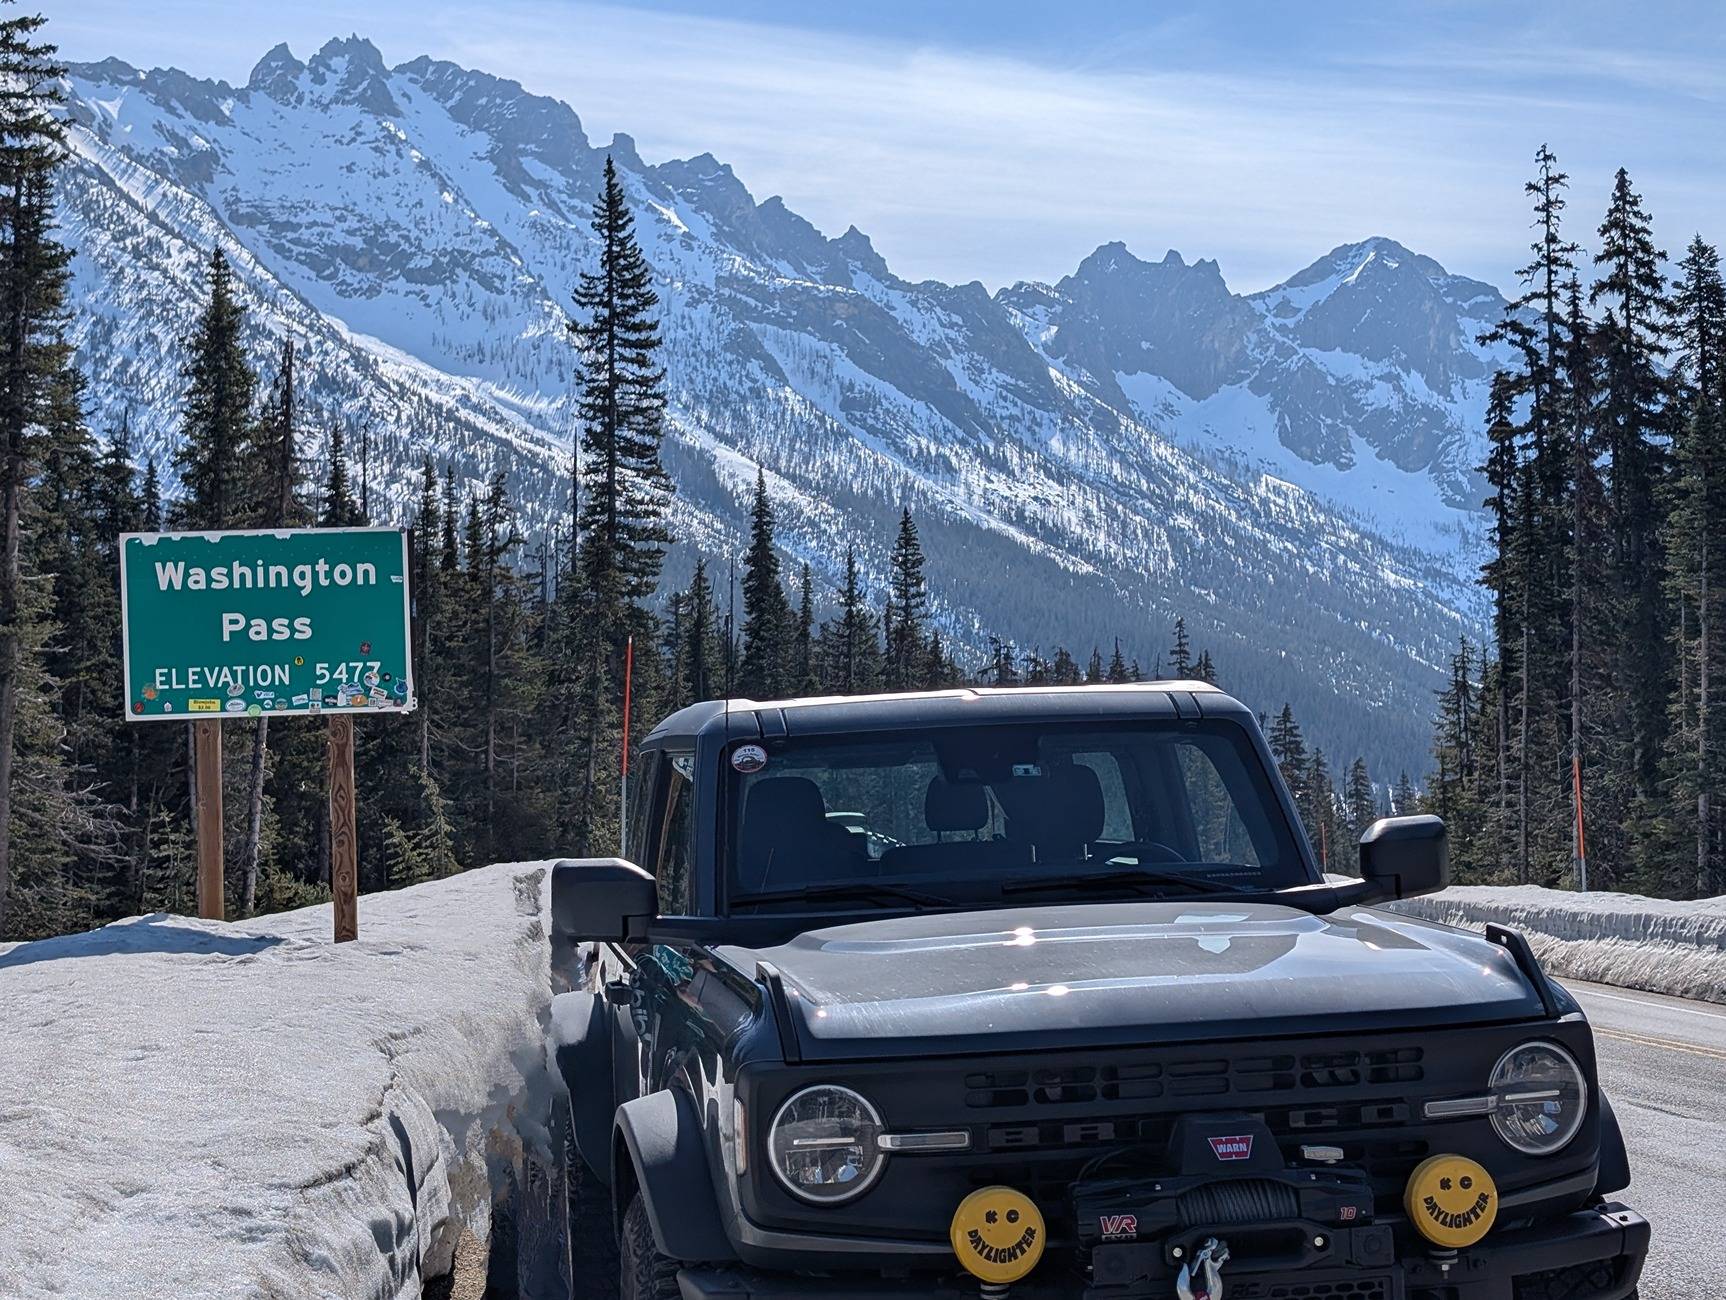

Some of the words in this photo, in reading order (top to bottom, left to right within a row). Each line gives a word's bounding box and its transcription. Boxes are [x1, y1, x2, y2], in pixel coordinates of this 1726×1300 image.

[155, 558, 376, 596] Washington
[222, 612, 313, 642] Pass
[155, 664, 290, 690] ELEVATION
[315, 661, 382, 685] 5477
[1216, 1142, 1248, 1153] WARN
[1099, 1214, 1138, 1234] VR
[1340, 1206, 1357, 1220] 10
[1423, 1192, 1490, 1229] DAYLIGHTER
[967, 1226, 1037, 1264] DAYLIGHTER
